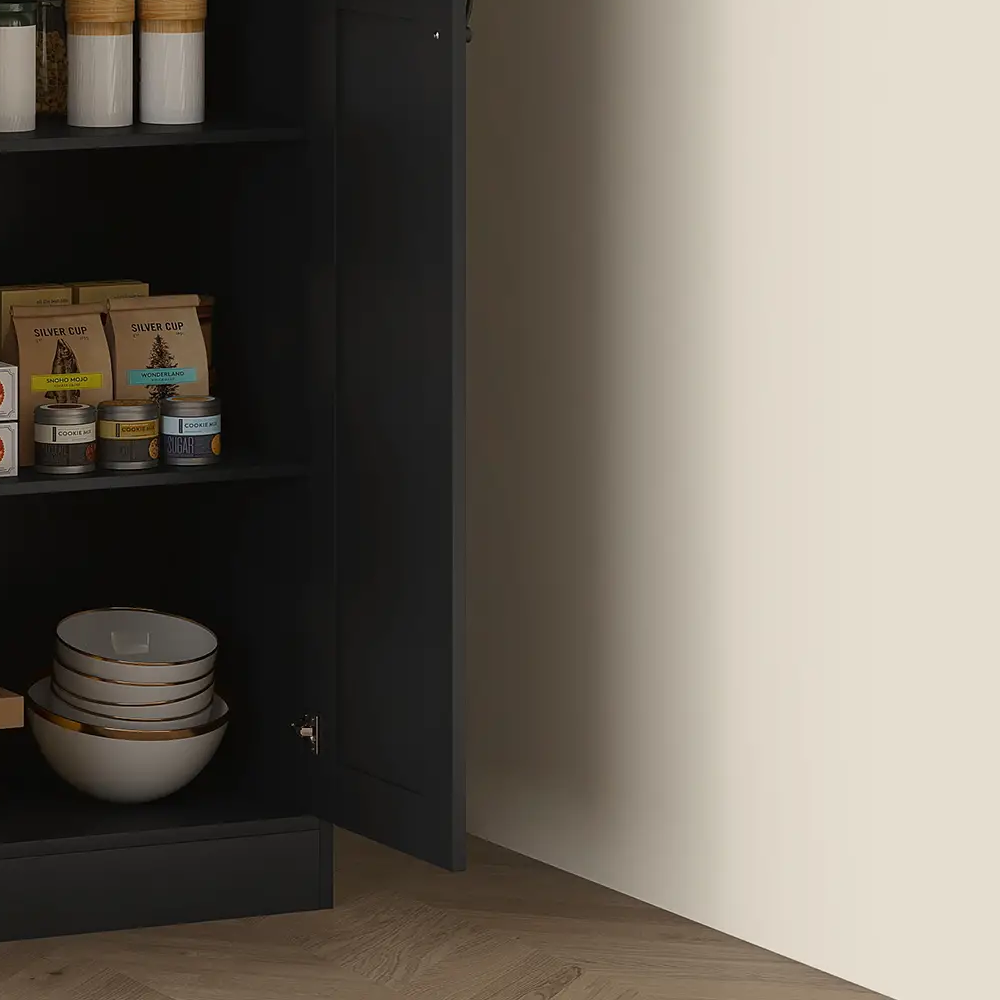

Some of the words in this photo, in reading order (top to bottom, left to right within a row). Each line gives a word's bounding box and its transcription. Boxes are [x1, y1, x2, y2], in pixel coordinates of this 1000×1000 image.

[33, 327, 66, 338] SILVER
[68, 326, 88, 336] CUP
[131, 322, 163, 333] SILVER
[165, 321, 184, 331] CUP
[168, 436, 194, 454] SUGAR
